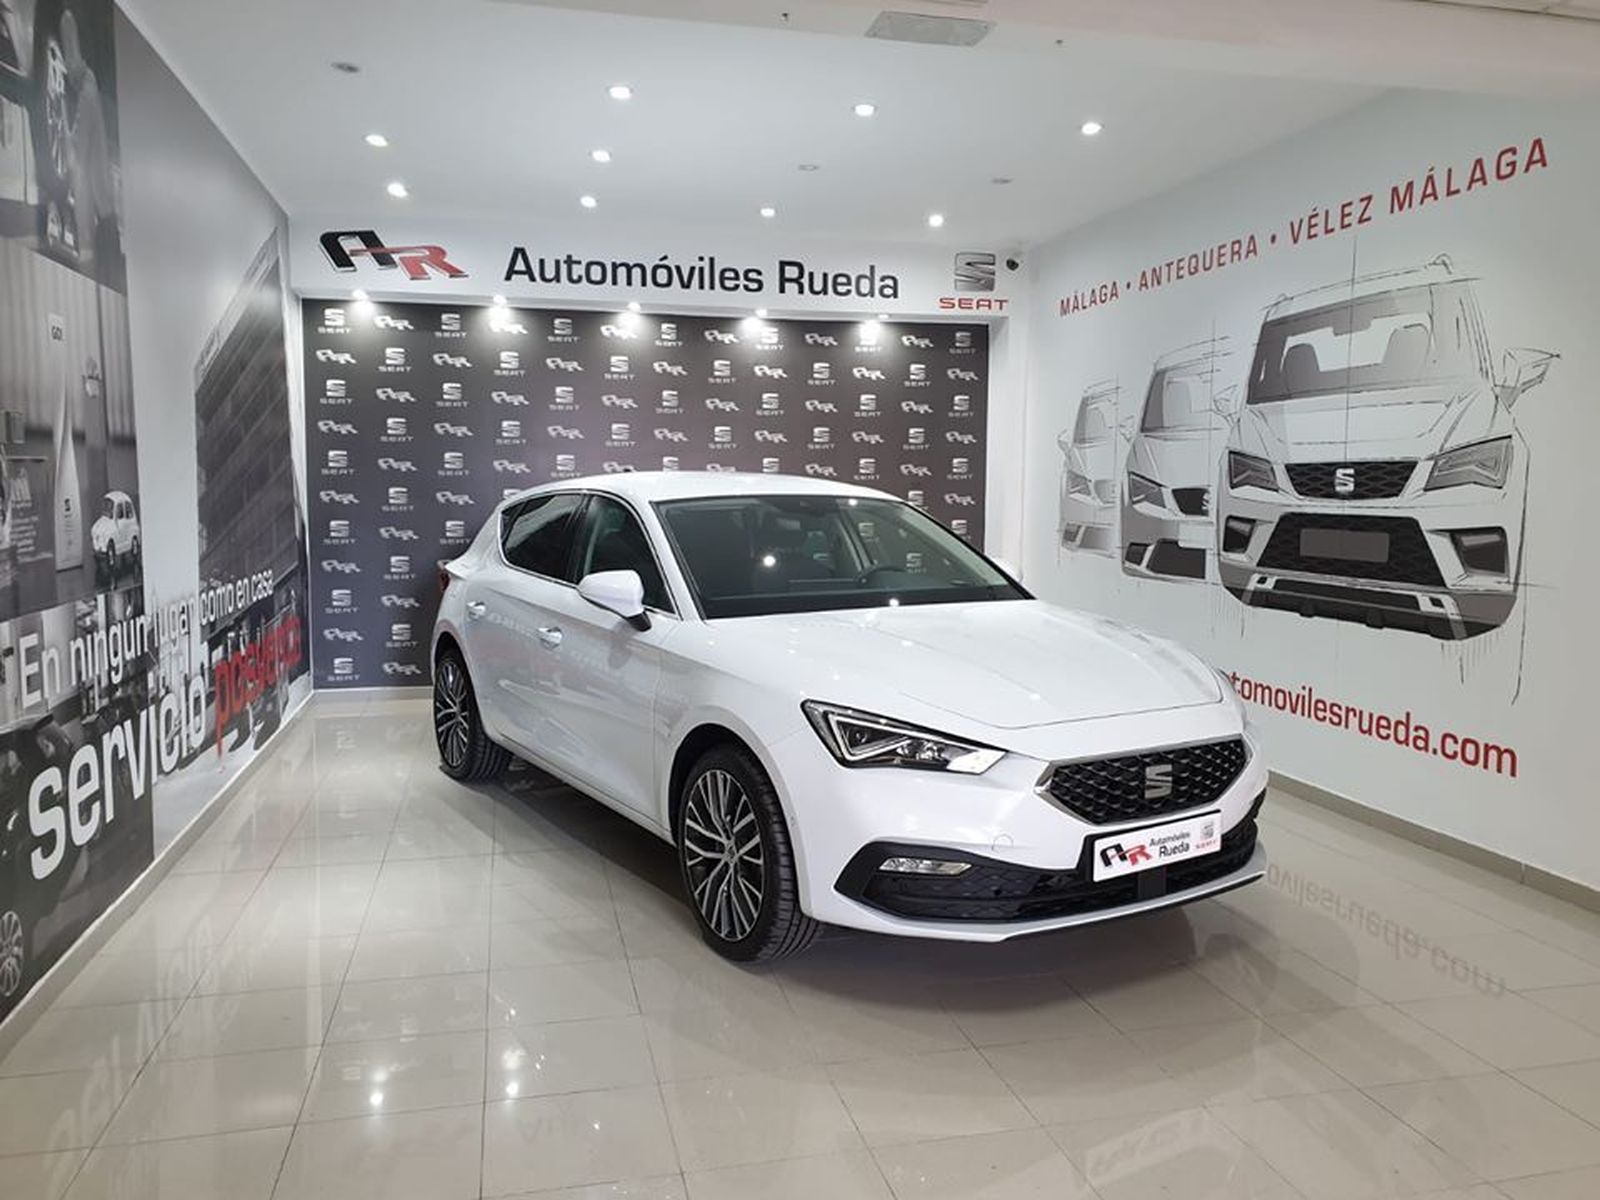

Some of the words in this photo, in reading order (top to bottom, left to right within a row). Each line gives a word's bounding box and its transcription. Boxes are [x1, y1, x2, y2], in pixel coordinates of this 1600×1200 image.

[503, 246, 765, 294] Automóviles
[777, 259, 901, 300] Rueda
[1059, 281, 1119, 317] MÁLAGA
[1138, 234, 1259, 292] ANTEQUERA
[1289, 193, 1374, 245] VÉLEZ
[1389, 137, 1548, 215] MÁLAGA
[938, 297, 1009, 311] SEAT
[19, 632, 61, 709] En
[69, 605, 150, 686] ningún
[200, 582, 235, 626] como
[235, 577, 250, 610] en
[251, 569, 274, 603] casa
[28, 671, 206, 881] servicio
[1230, 671, 1518, 778] tomovilesrueda.com
[1158, 841, 1190, 858] Rueda
